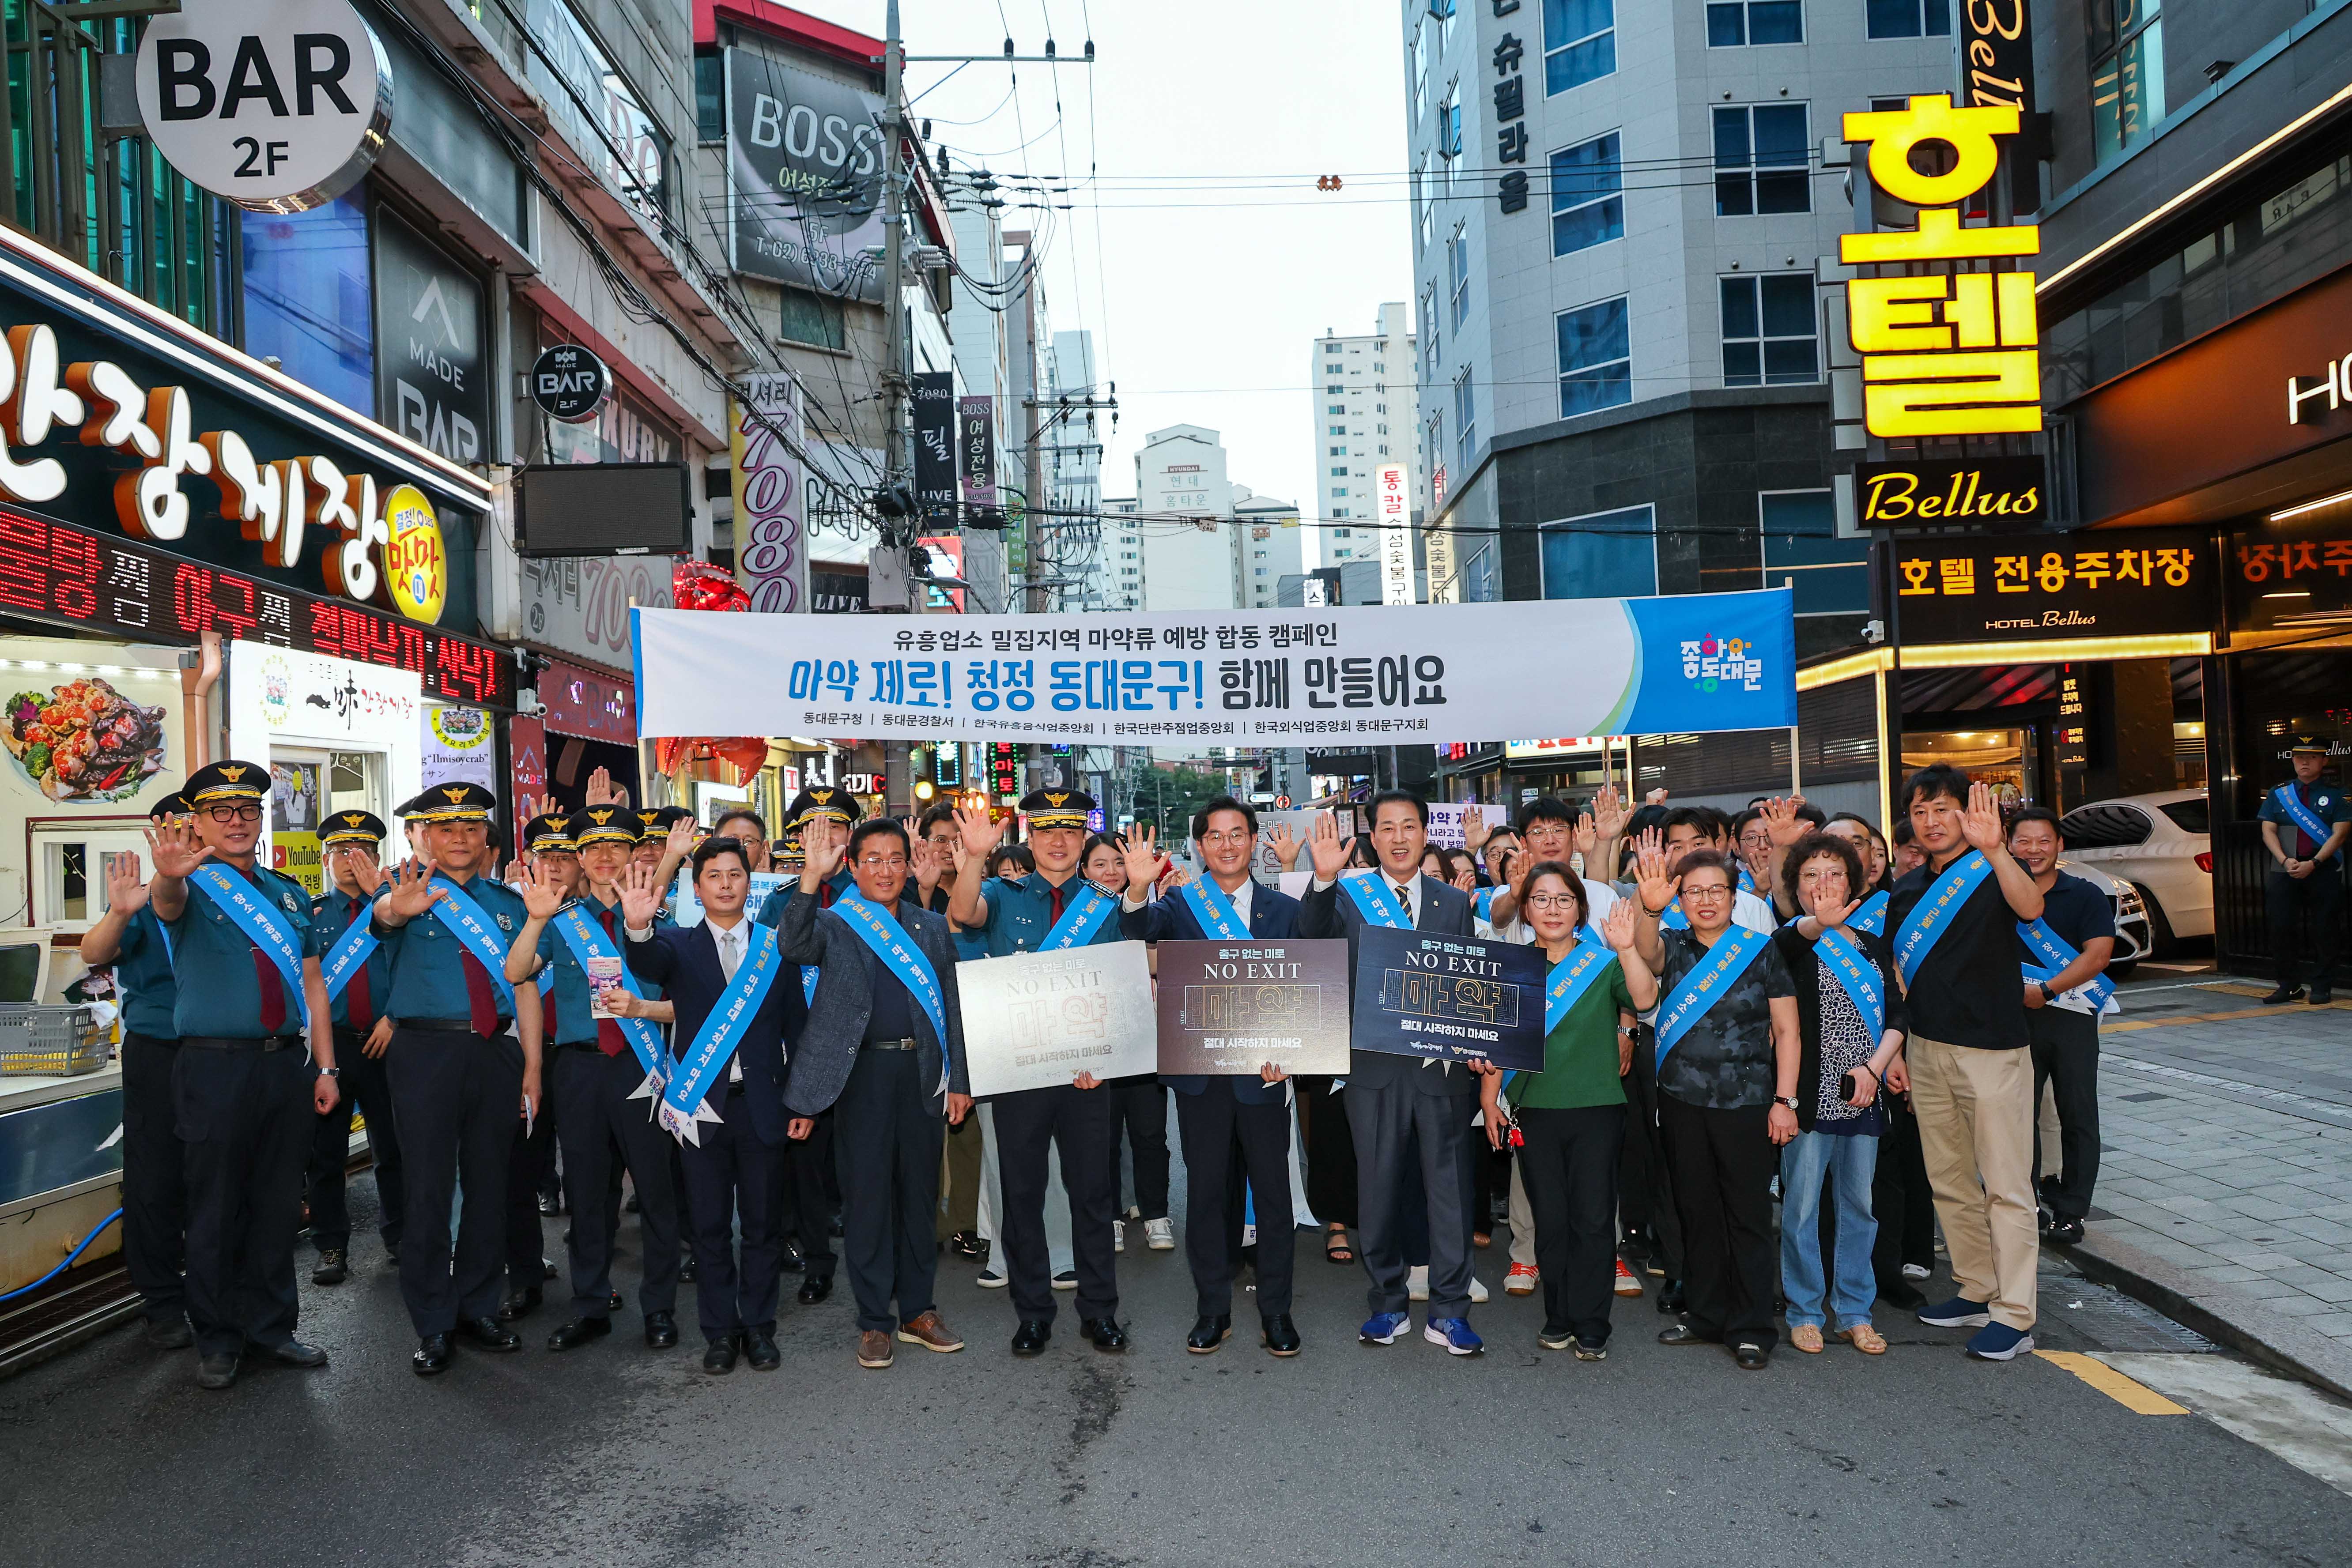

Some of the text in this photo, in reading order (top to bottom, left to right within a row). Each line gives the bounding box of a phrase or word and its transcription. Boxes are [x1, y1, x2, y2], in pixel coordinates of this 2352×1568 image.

[156, 34, 359, 121] BAR
[751, 92, 879, 176] BOSS
[234, 136, 288, 177] 2F
[809, 222, 829, 243] 5F
[772, 241, 798, 263] 02)
[1839, 94, 2043, 438] 호텔
[410, 336, 464, 392] MADE
[538, 371, 596, 394] BAR
[559, 400, 578, 409] 2F
[963, 403, 989, 415] BOSS
[969, 418, 986, 490] 여성전용
[1170, 475, 1199, 488] 현대
[1165, 494, 1207, 508] 홈타운
[1865, 471, 2039, 521] Bellus
[395, 507, 434, 531] 결정! SBS
[1899, 548, 2195, 597] 호텔 전용주차장
[815, 593, 863, 611] LIVE
[532, 604, 544, 631] 2F
[1986, 610, 2096, 629] HOTEL Bellus
[893, 622, 1338, 652] 유흥업소 밀집지역 마약류 예방 합동 캠페인
[789, 654, 1447, 712] 마약 제로! 청정 동대문구! 함께 만들어요
[803, 712, 1429, 735] 동대문구청 동대문경찰서 한국유흥음식업중앙회 한국단란주점업중앙회 한국외식업중앙회 동대문구지회
[2325, 741, 2351, 756] ellus
[287, 843, 321, 866] YouTube
[1192, 877, 1207, 900] 약류
[1204, 898, 1222, 924] 근절,
[1370, 898, 1391, 919] 마약
[208, 871, 301, 976] 근절, 장소 제공한 업소도
[1068, 914, 1087, 936] 장소
[1904, 876, 1966, 952] 마약류 근절, 장소
[461, 915, 483, 935] 마약
[479, 935, 501, 957] 절대
[330, 937, 364, 976] 마약 절대
[1219, 948, 1285, 960] 출구 없는 미로
[1420, 939, 1486, 957] 출구 없는 미로
[1717, 943, 1743, 971] 마약류
[2042, 941, 2062, 960] 장소
[891, 943, 913, 965] 마약
[909, 964, 930, 986] 절대
[1042, 961, 1063, 975] 없는
[1065, 957, 1086, 970] 미로
[1204, 962, 1302, 979] NO EXIT
[1405, 951, 1502, 977] NO EXIT
[1570, 951, 1597, 977] 마약류
[743, 974, 759, 997] 마약
[801, 966, 816, 987] 소도
[1006, 971, 1102, 998] NO EXIT
[1693, 970, 1720, 993] 근절,
[1840, 957, 1862, 984] 미로,
[1860, 982, 1878, 1004] 마약
[727, 996, 747, 1022] 절대
[1676, 992, 1698, 1015] 장소
[1401, 1019, 1499, 1042] 절대 시작하지 마세요
[698, 1021, 732, 1067] 시작하지
[1204, 1037, 1302, 1049] 절대 시작하지 마세요
[1015, 1044, 1113, 1067] 절대 시작하지 마세요
[677, 1067, 701, 1101] 마세요
